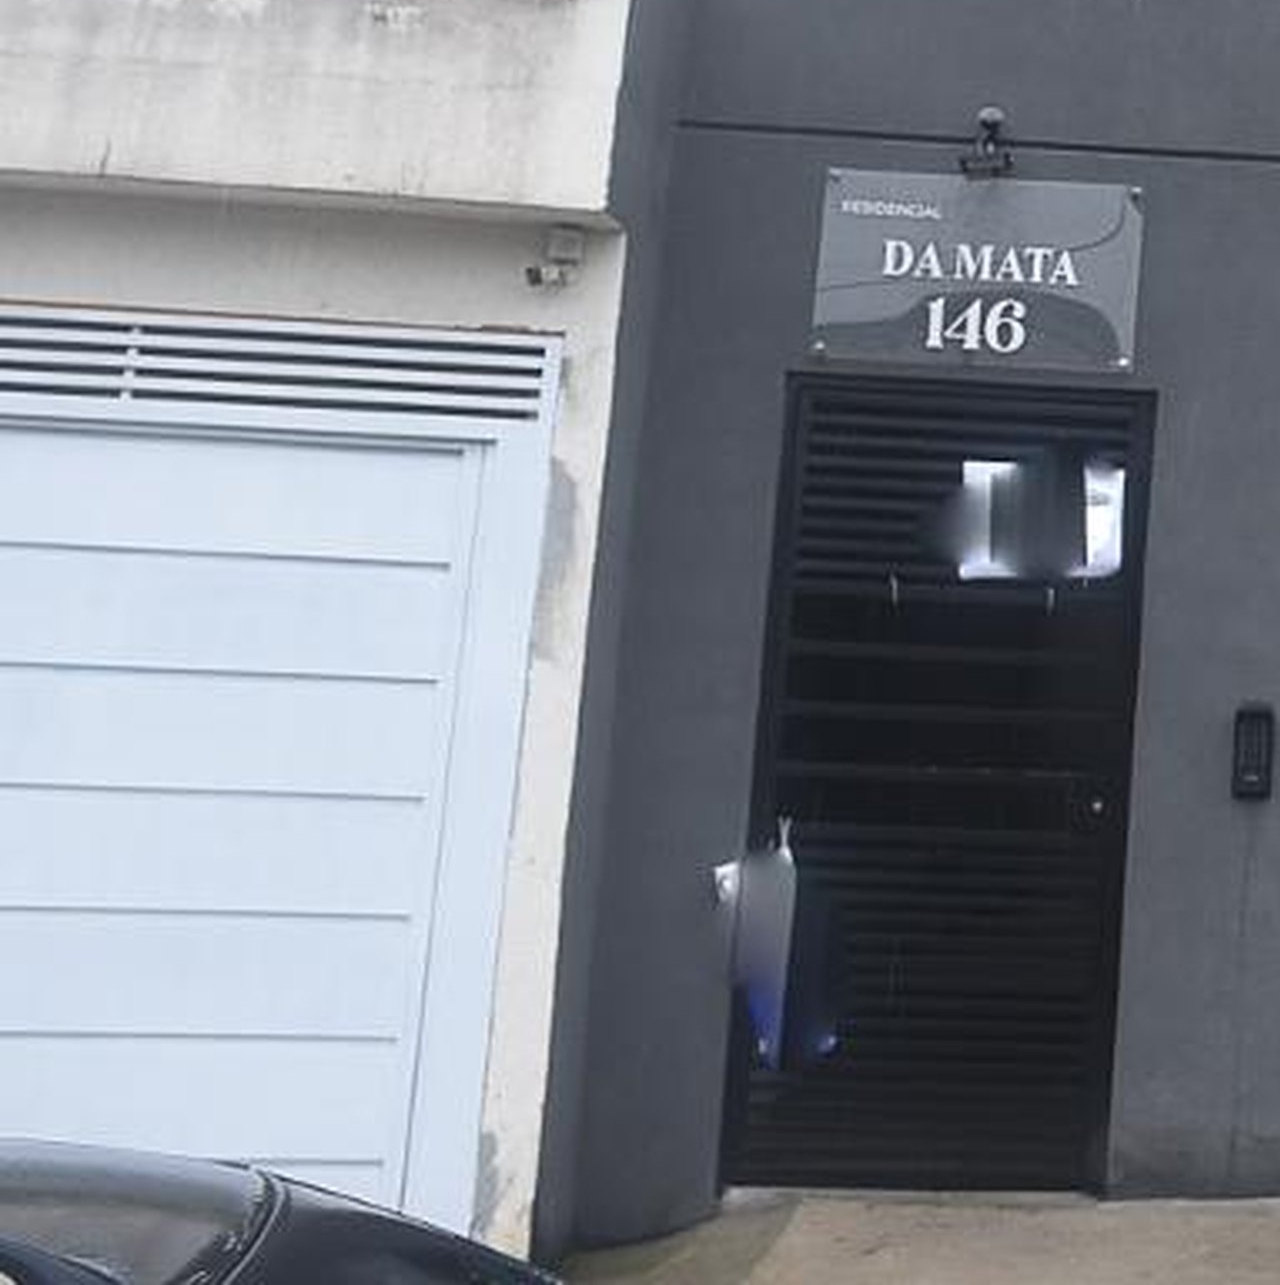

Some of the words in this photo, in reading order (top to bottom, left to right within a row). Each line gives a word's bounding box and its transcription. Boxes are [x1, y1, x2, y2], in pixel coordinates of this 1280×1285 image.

[882, 239, 943, 278] DA
[953, 244, 1079, 285] MATA
[925, 296, 1027, 353] 146
